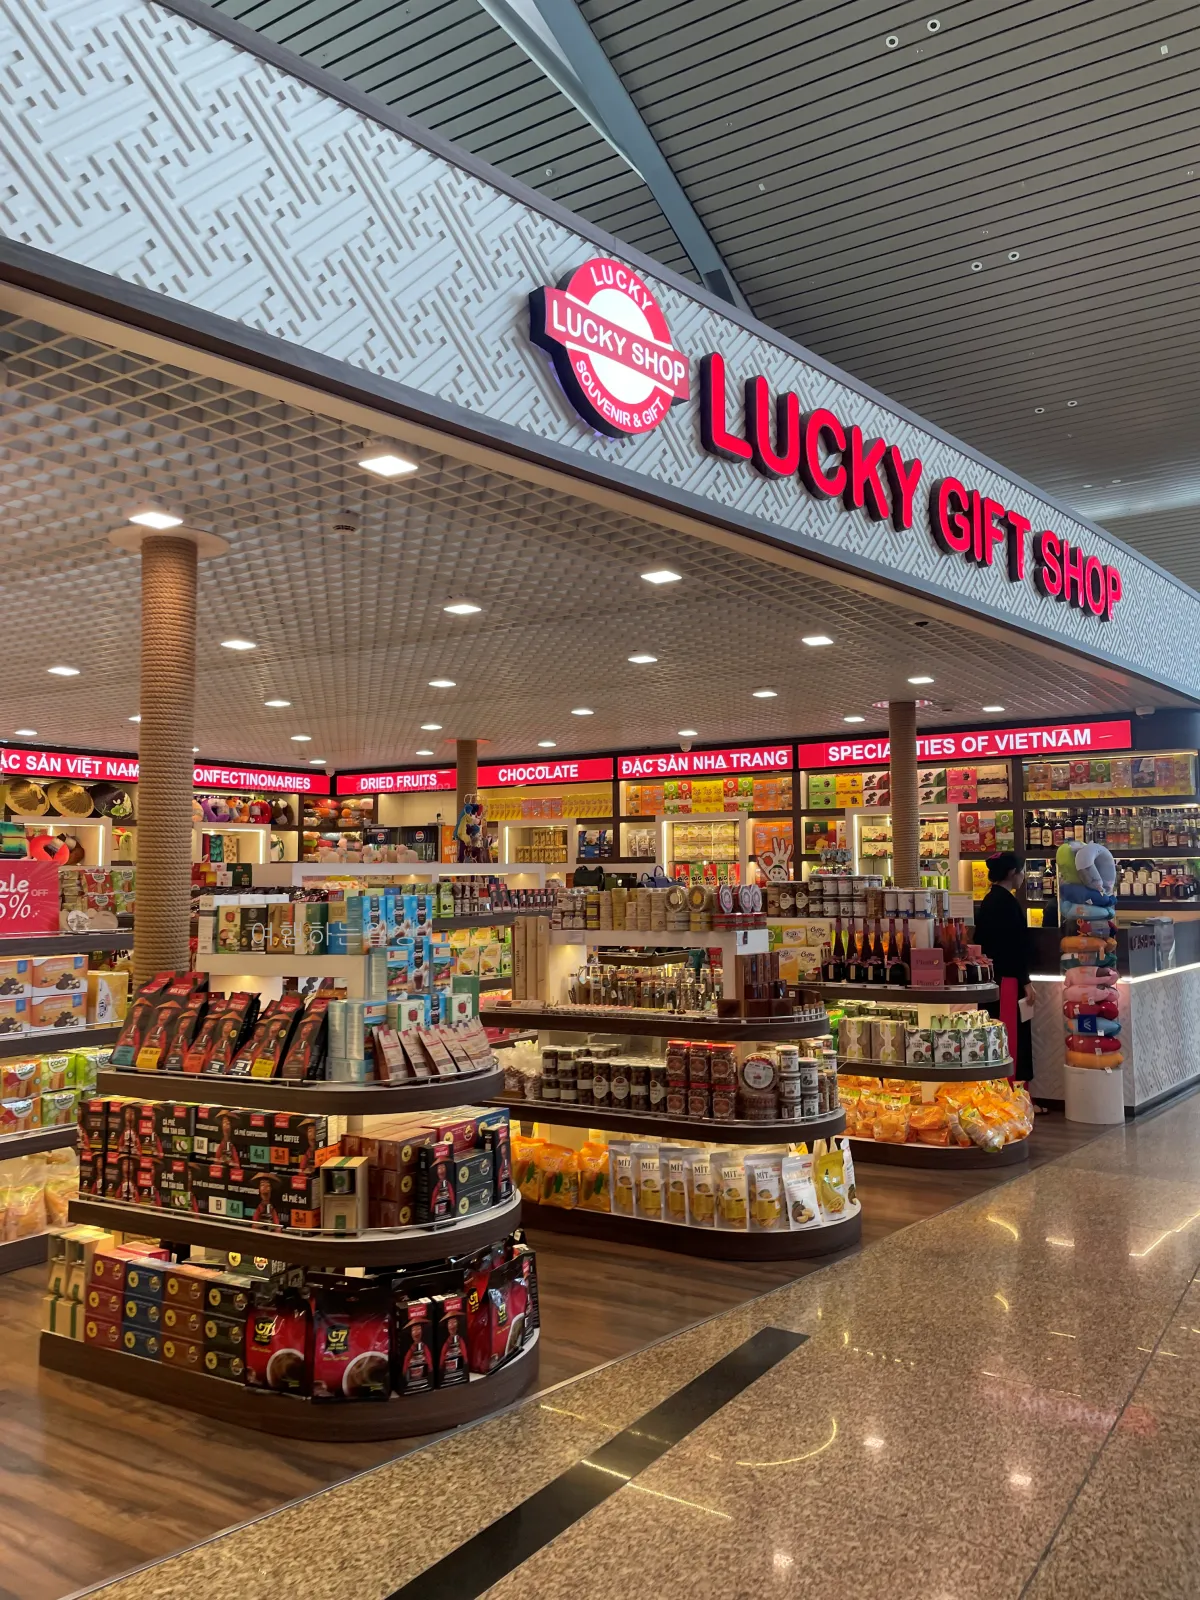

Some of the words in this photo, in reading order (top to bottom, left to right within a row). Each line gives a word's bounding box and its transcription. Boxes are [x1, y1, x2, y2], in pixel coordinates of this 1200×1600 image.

[590, 264, 653, 311] LUCKY
[552, 299, 627, 356] LUCKY
[631, 342, 686, 386] SHOP
[576, 360, 632, 427] SOUVENIR
[633, 413, 642, 428] &
[642, 396, 665, 425] GIFT
[700, 351, 923, 532] LUCKY
[929, 476, 1032, 582] GIFT
[1033, 530, 1122, 622] SHOP
[828, 738, 956, 762] SPECIATIES
[961, 735, 989, 753] OF
[994, 728, 1092, 750] VIETNAM
[0, 751, 20, 772] ẶC
[25, 753, 62, 772] SẢN
[66, 757, 103, 777] VIỆT
[106, 762, 139, 777] NAM
[498, 764, 579, 783] CHOCOLATE
[622, 757, 653, 777] ĐẶC
[657, 754, 689, 772] SẢN
[693, 755, 725, 769] NHA
[729, 750, 788, 767] TRANG
[193, 769, 311, 790] ONFECTINONARIES
[360, 776, 394, 790] DRIED
[396, 773, 437, 788] FRUITS
[0, 873, 29, 893] ale
[31, 889, 49, 897] OFF
